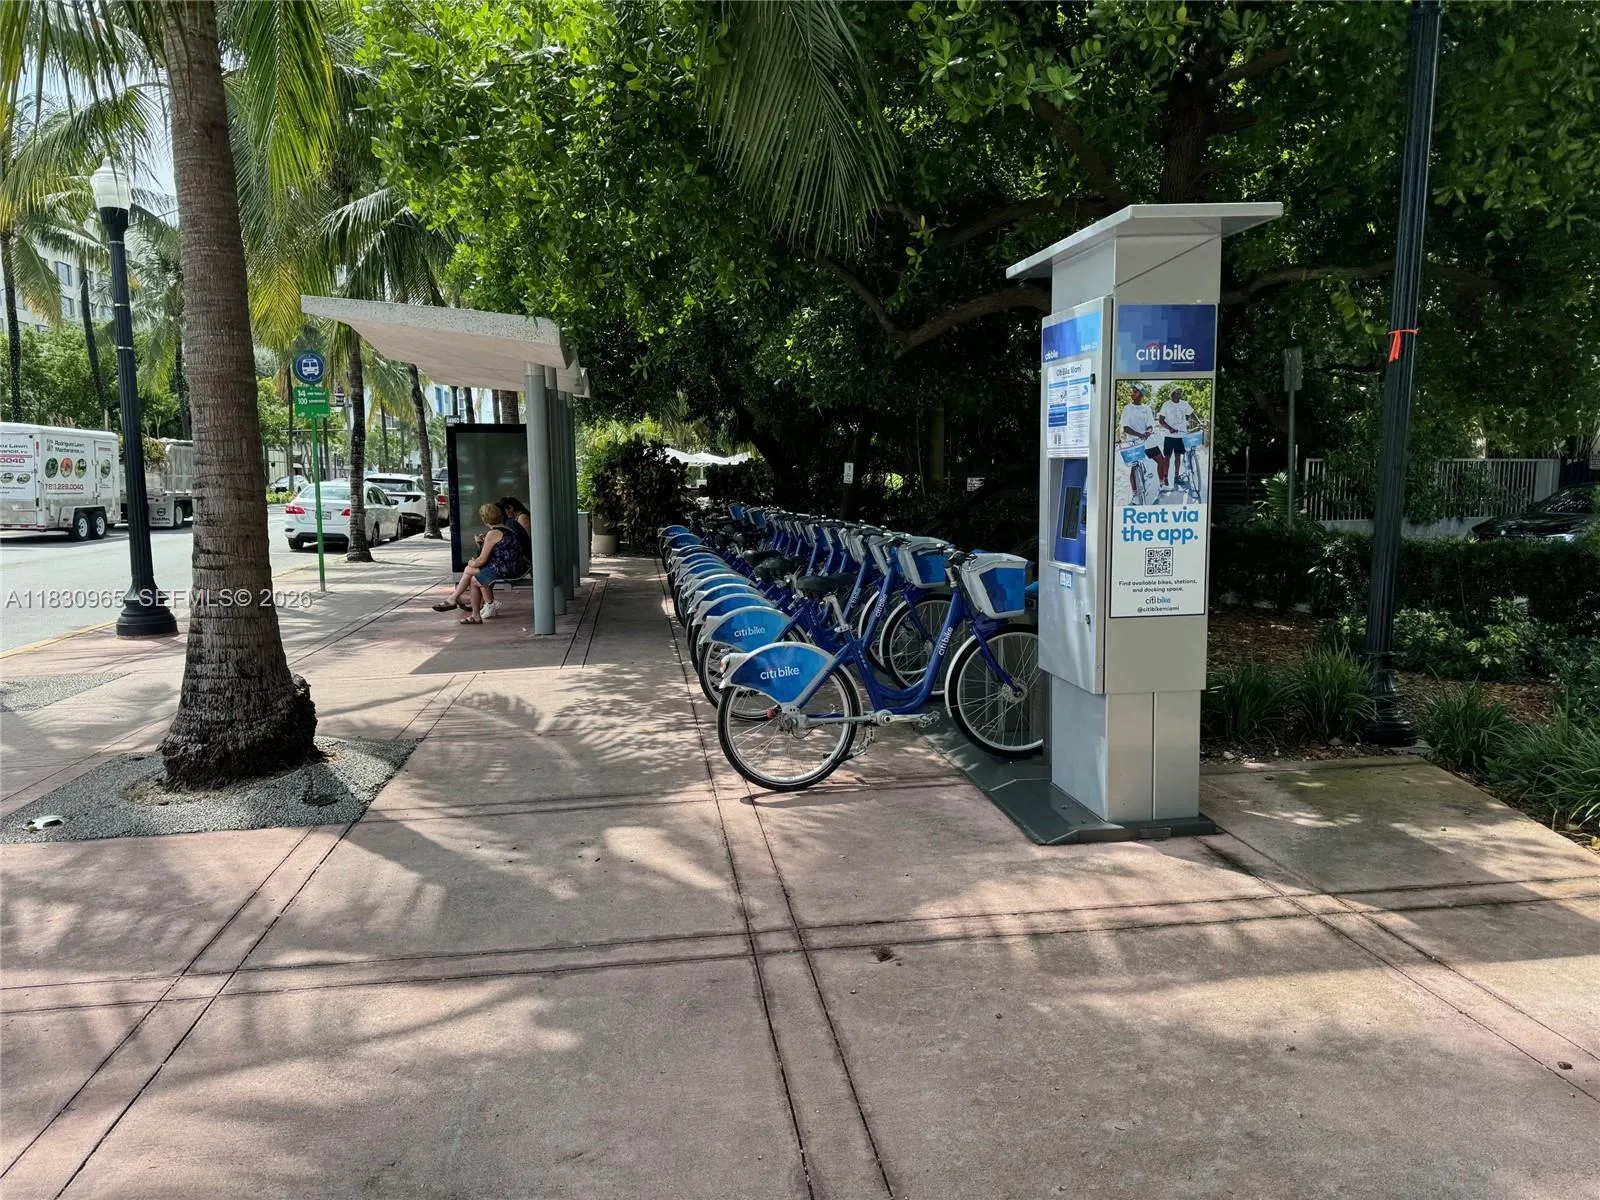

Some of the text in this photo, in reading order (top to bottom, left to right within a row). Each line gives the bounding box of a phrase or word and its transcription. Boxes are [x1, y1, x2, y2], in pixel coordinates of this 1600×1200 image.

[1136, 344, 1195, 361] citi bike
[1123, 506, 1199, 524] Rent via
[1121, 525, 1199, 545] the app.
[1132, 579, 1157, 587] available
[1157, 578, 1174, 586] bikes,
[1144, 586, 1166, 594] docking
[1145, 595, 1157, 605] citi
[734, 625, 766, 637] citi bike
[760, 665, 800, 680] citi bike
